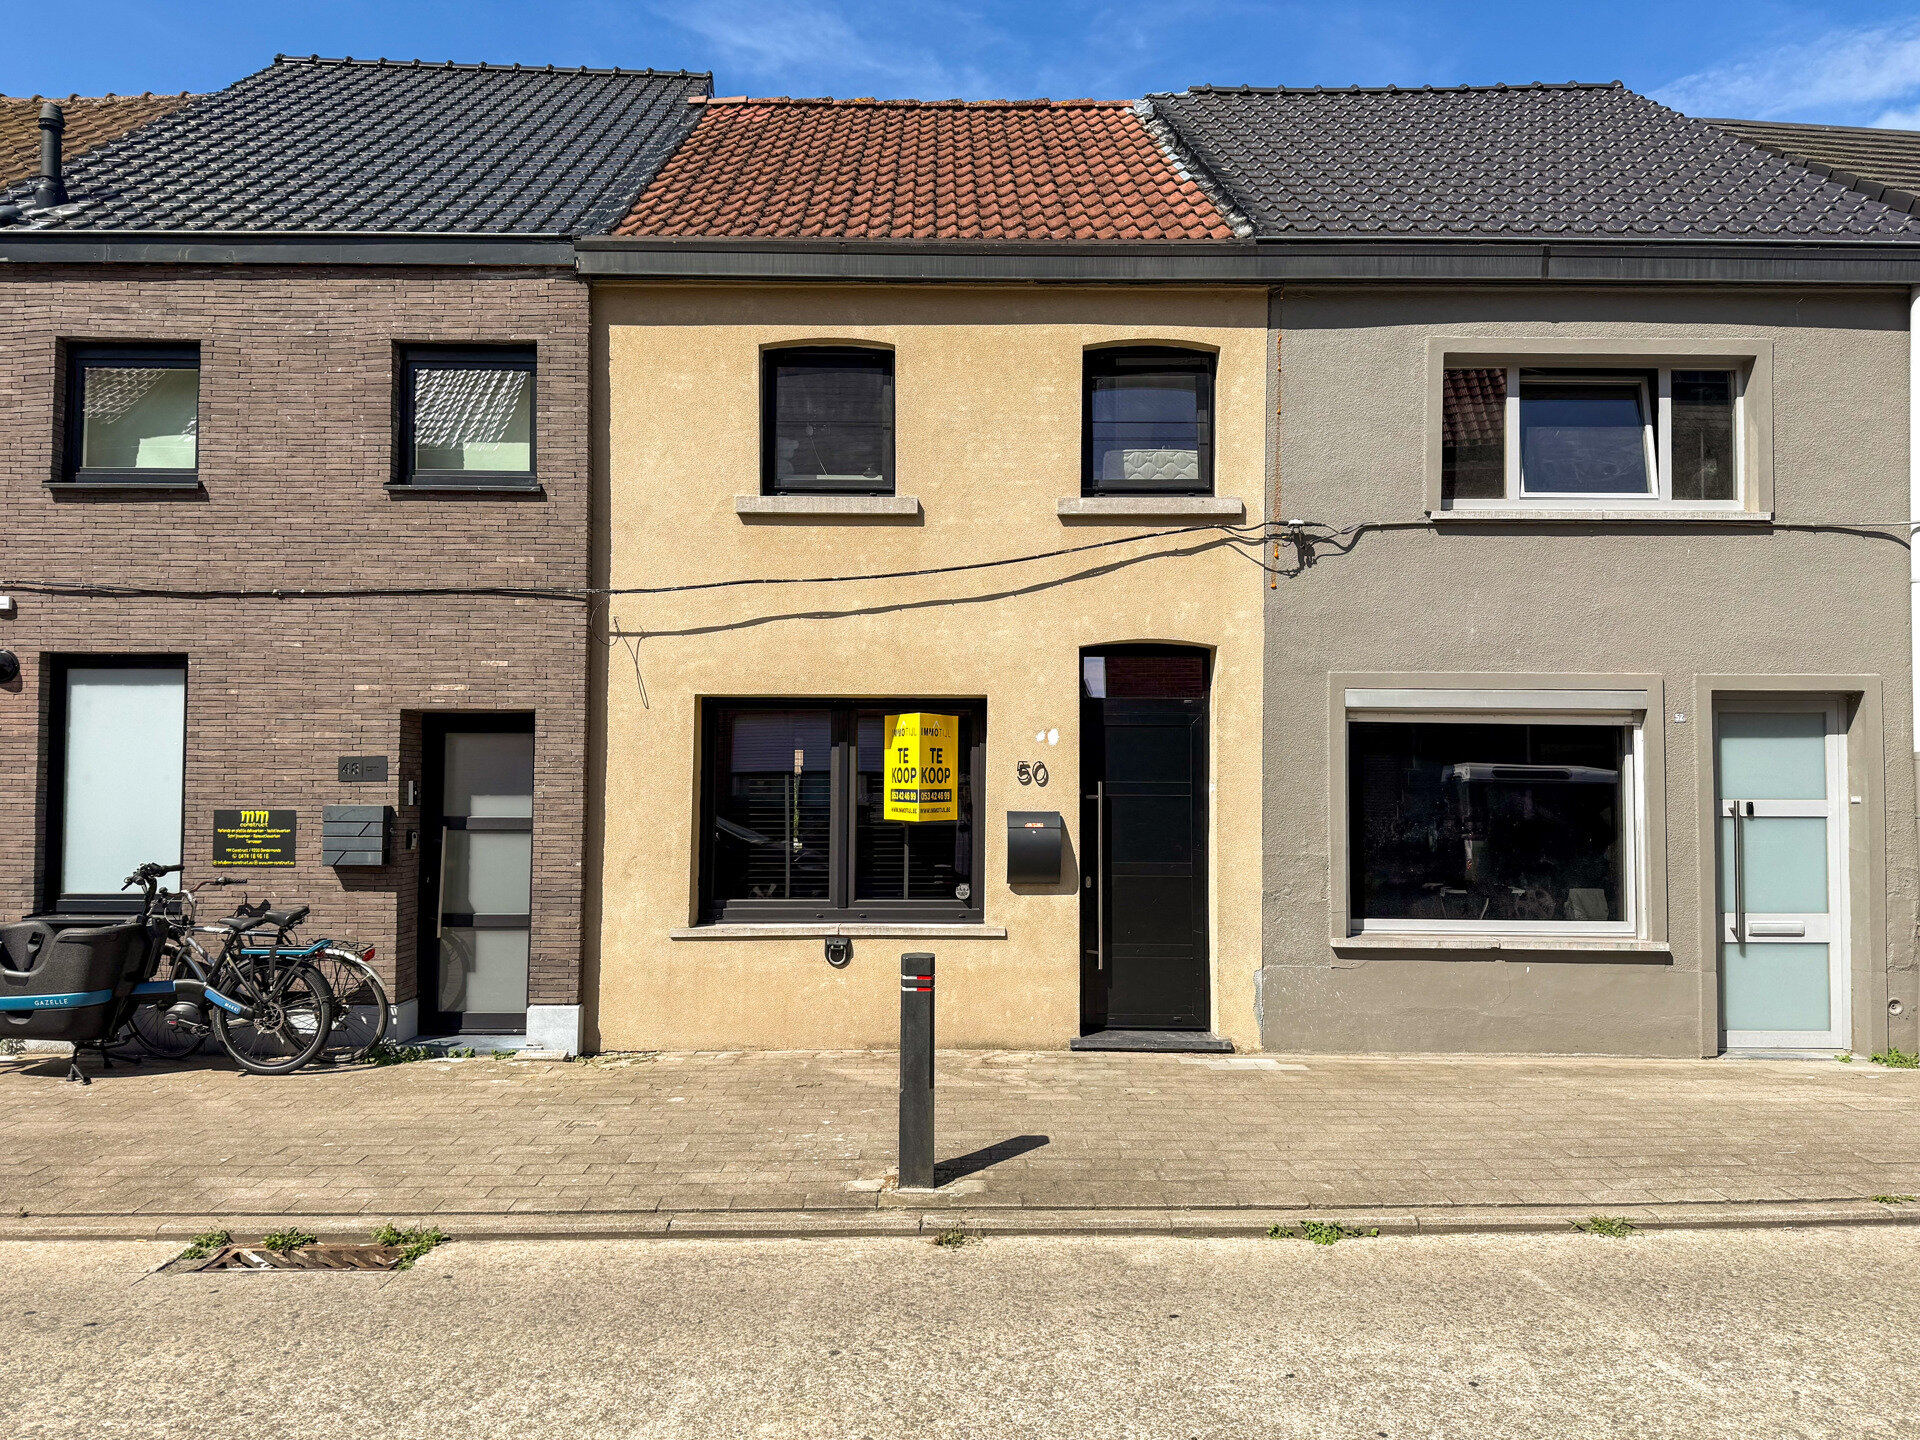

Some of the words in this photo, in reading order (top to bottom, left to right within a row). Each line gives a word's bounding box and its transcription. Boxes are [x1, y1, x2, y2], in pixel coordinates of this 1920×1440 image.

[898, 748, 908, 764] TE
[930, 748, 943, 764] TE
[342, 762, 360, 774] 48
[892, 767, 916, 784] KOOP
[920, 767, 950, 784] KOOP
[1017, 761, 1047, 784] 50
[921, 792, 930, 800] 053
[931, 792, 937, 800] 42
[944, 792, 950, 800] 99
